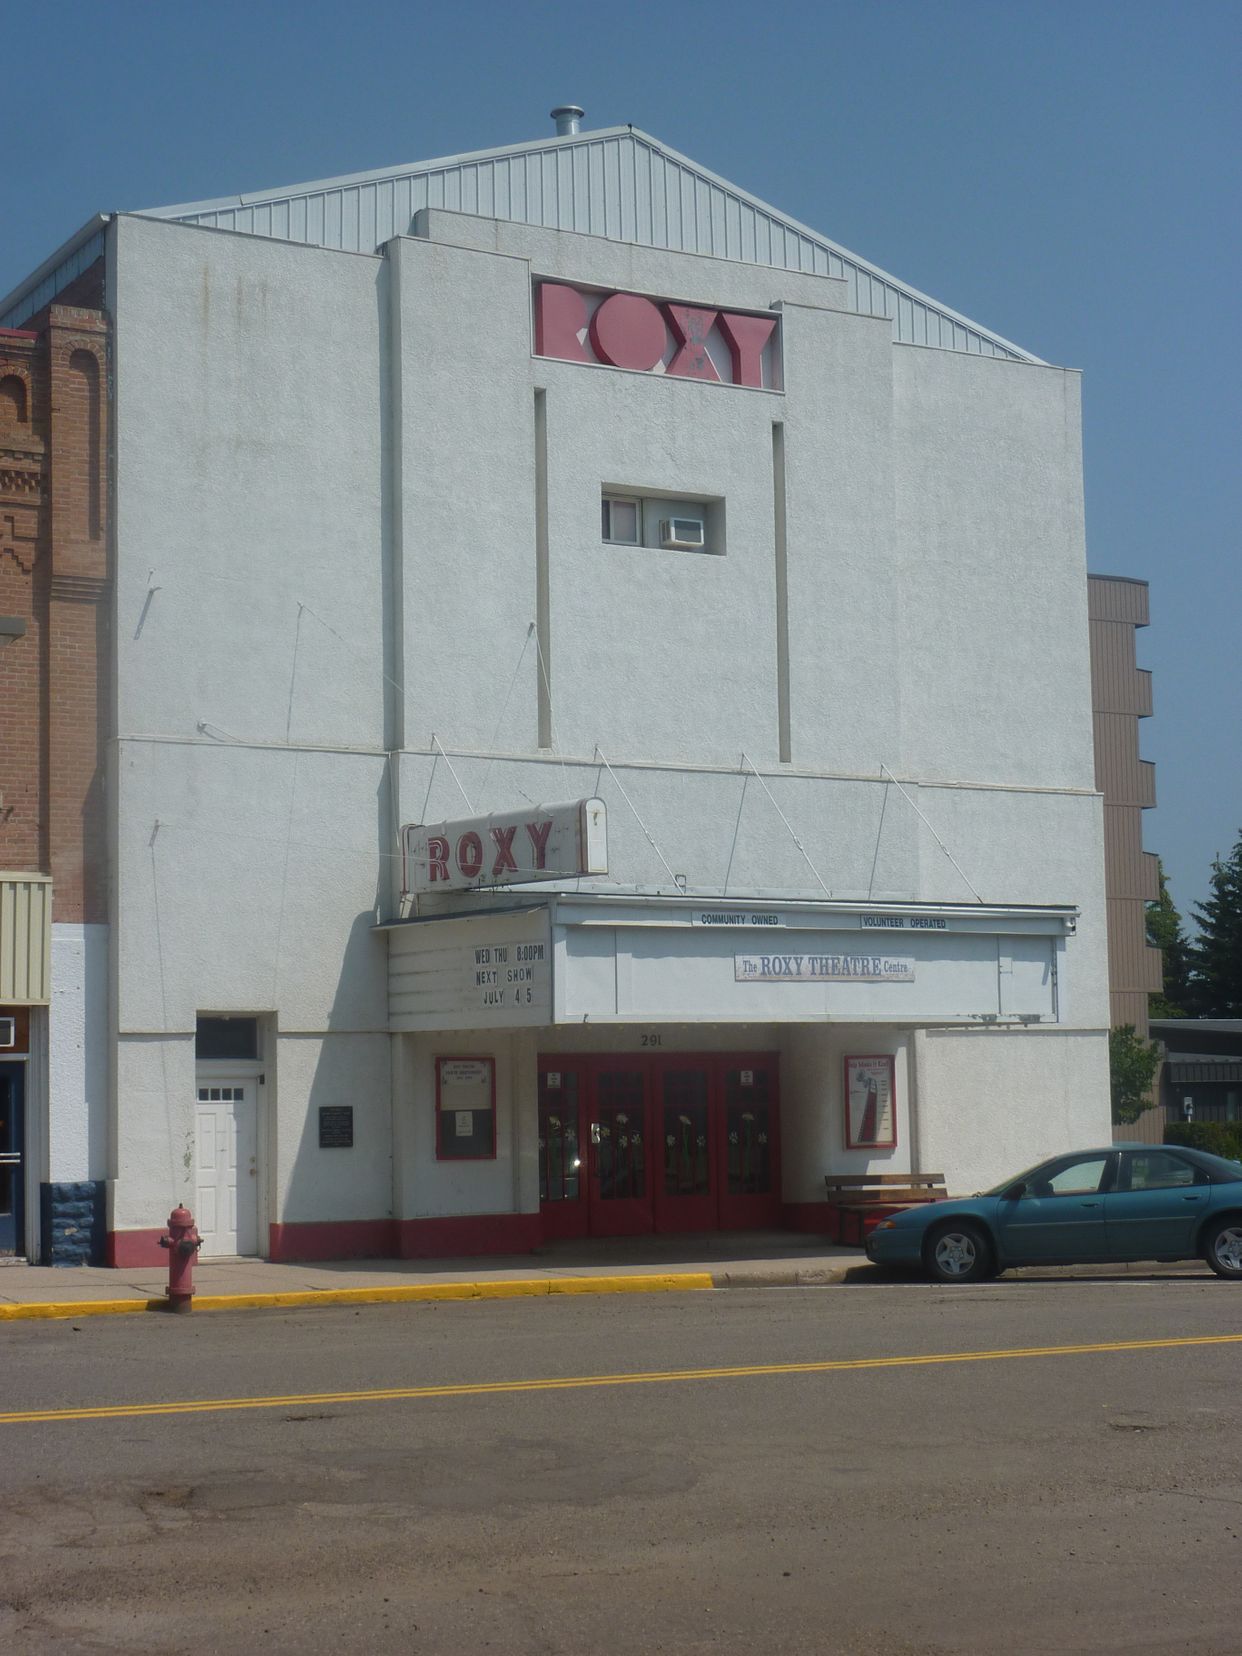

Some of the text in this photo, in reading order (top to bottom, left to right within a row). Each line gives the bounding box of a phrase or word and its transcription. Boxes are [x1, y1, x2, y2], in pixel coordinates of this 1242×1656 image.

[536, 282, 777, 388] ROXY
[427, 820, 553, 882] ROXY
[701, 914, 779, 925] COMMUNITY OWNED
[863, 916, 946, 929] VOLUNTEER OPERATED
[475, 944, 544, 964] WED THU 8:00PM
[742, 956, 909, 976] The ROXY THEATRE Centre
[476, 967, 532, 986] NEXT SHOW
[484, 987, 532, 1005] JULY 4 5
[641, 1034, 662, 1047] 291
